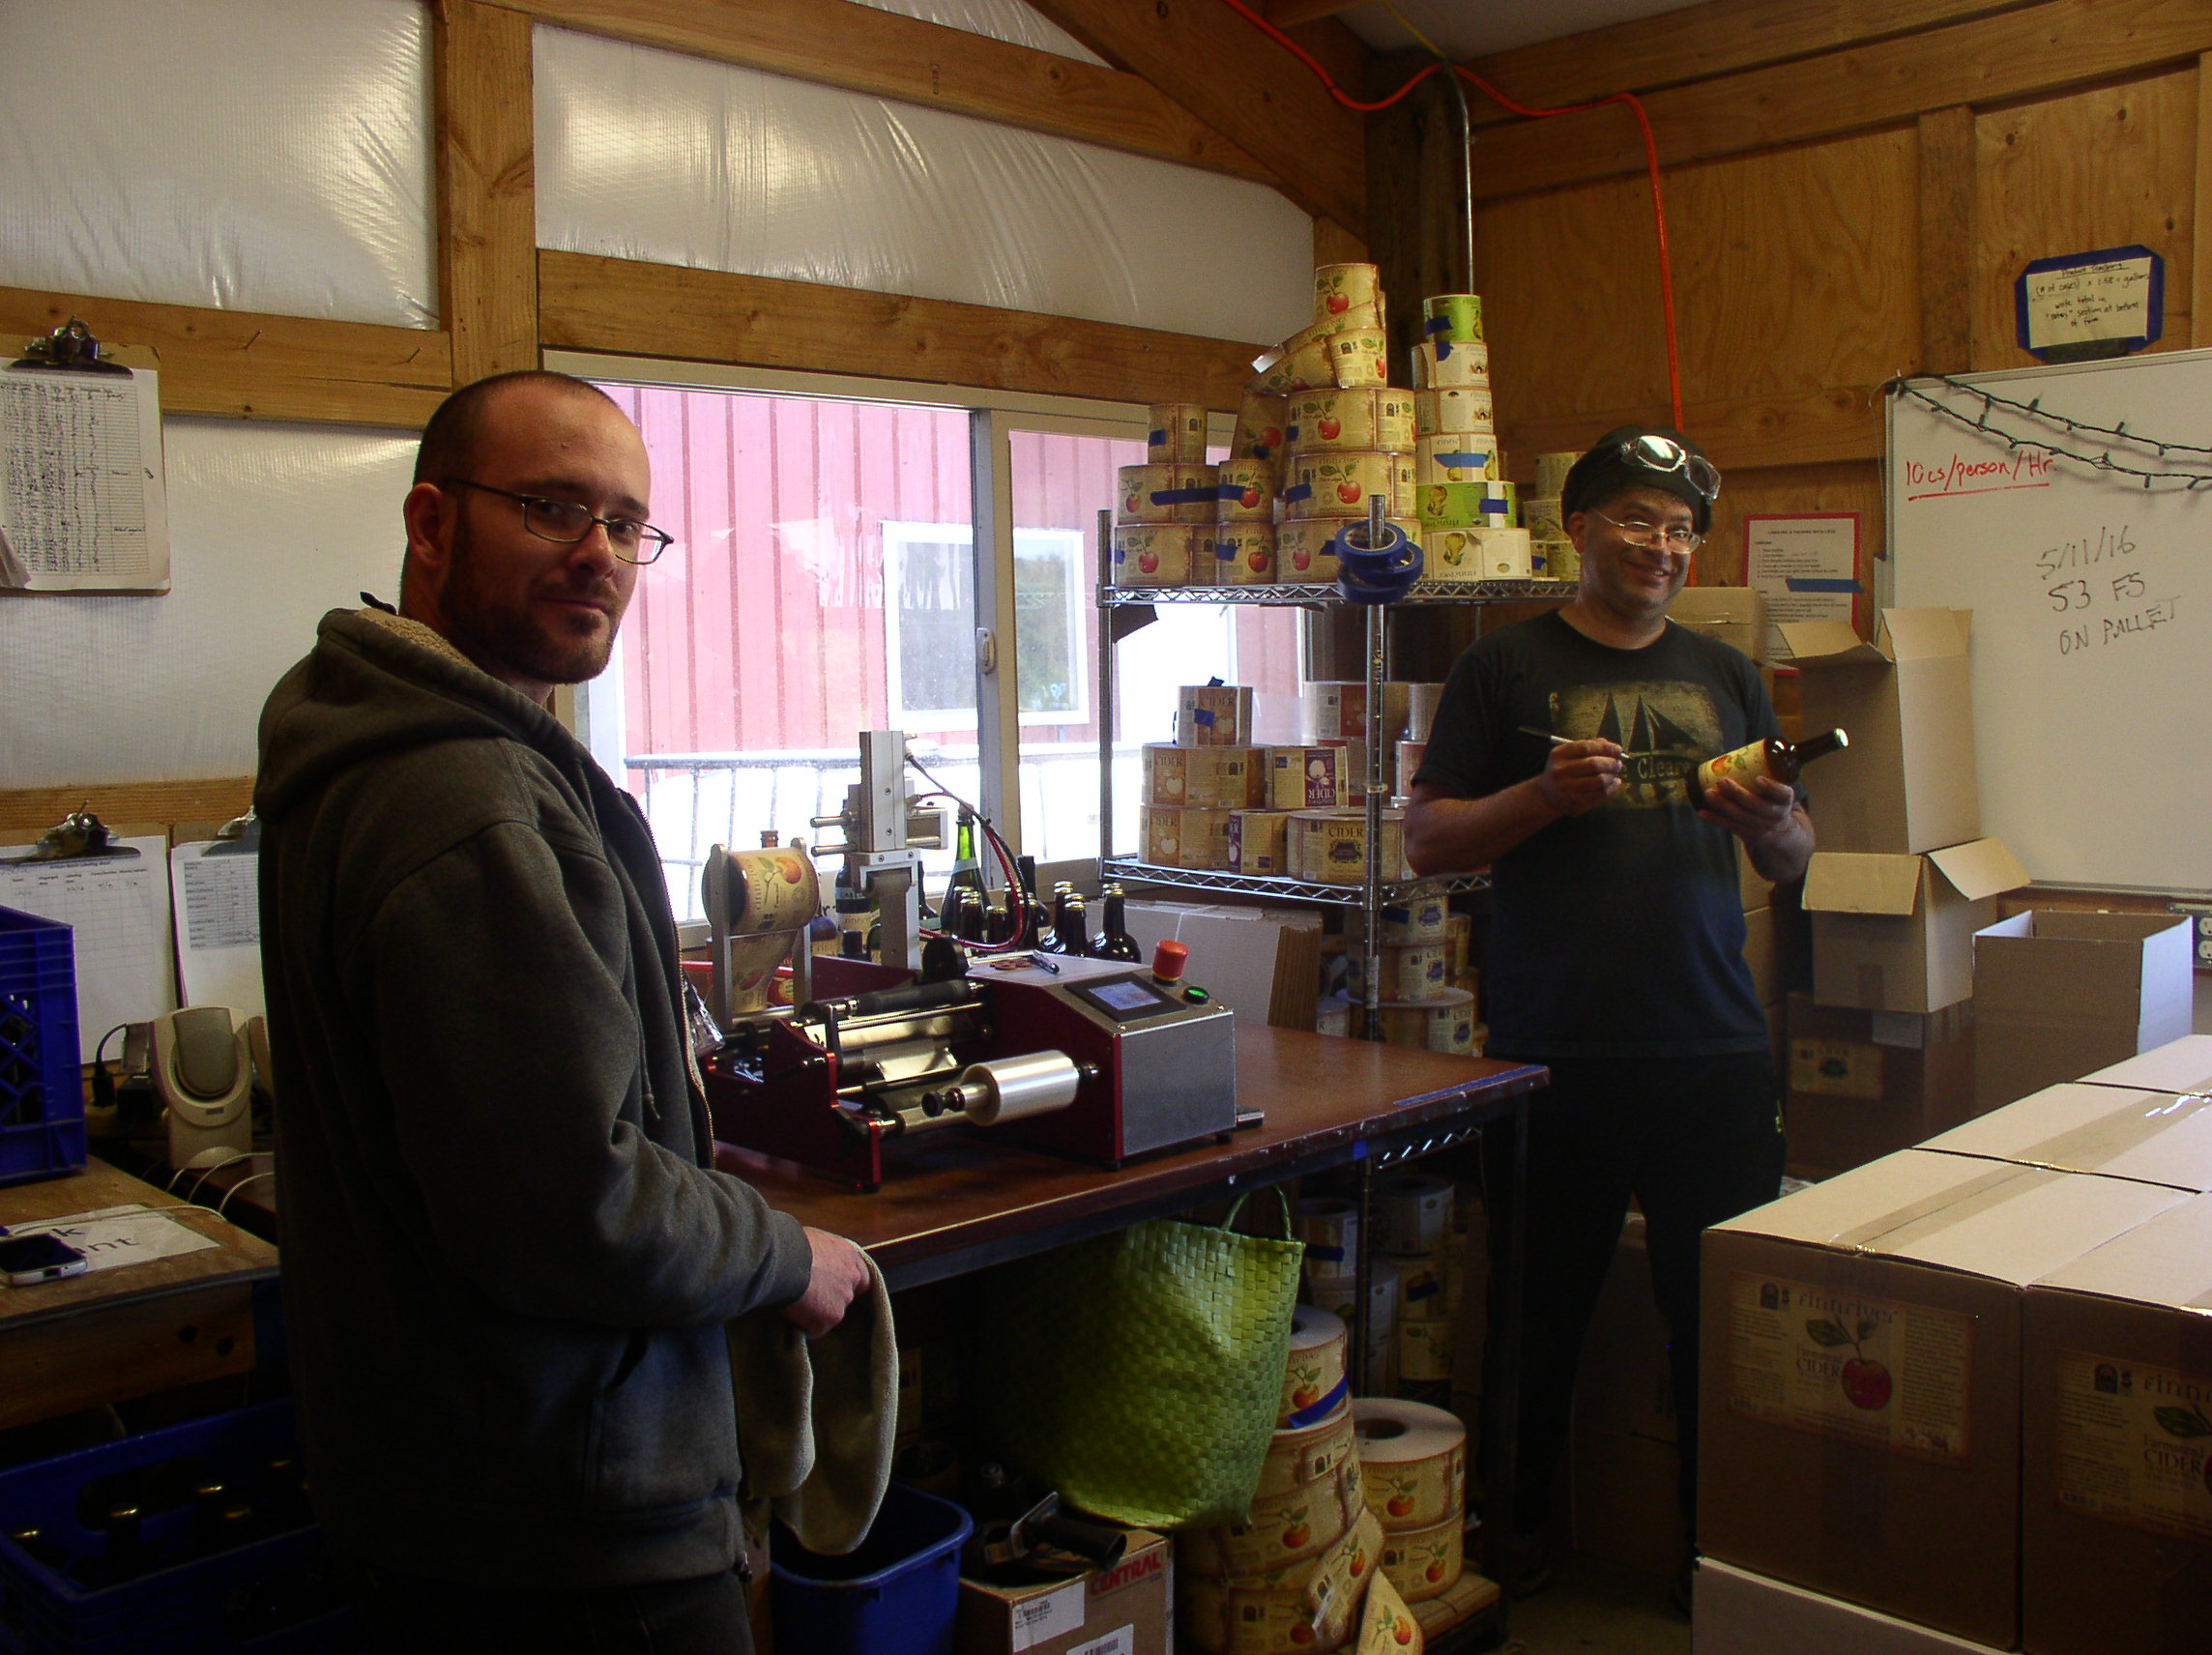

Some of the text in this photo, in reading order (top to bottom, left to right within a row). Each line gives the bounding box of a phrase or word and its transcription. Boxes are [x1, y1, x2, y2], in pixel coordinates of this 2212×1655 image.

[2036, 525, 2136, 581] 5/11/16
[2059, 595, 2181, 655] ON PALLET
[1328, 827, 1364, 838] CIDER
[1795, 1357, 1841, 1379] CIDER
[2143, 1448, 2203, 1475] CIDER
[1090, 1551, 1161, 1595] CENTRAL
